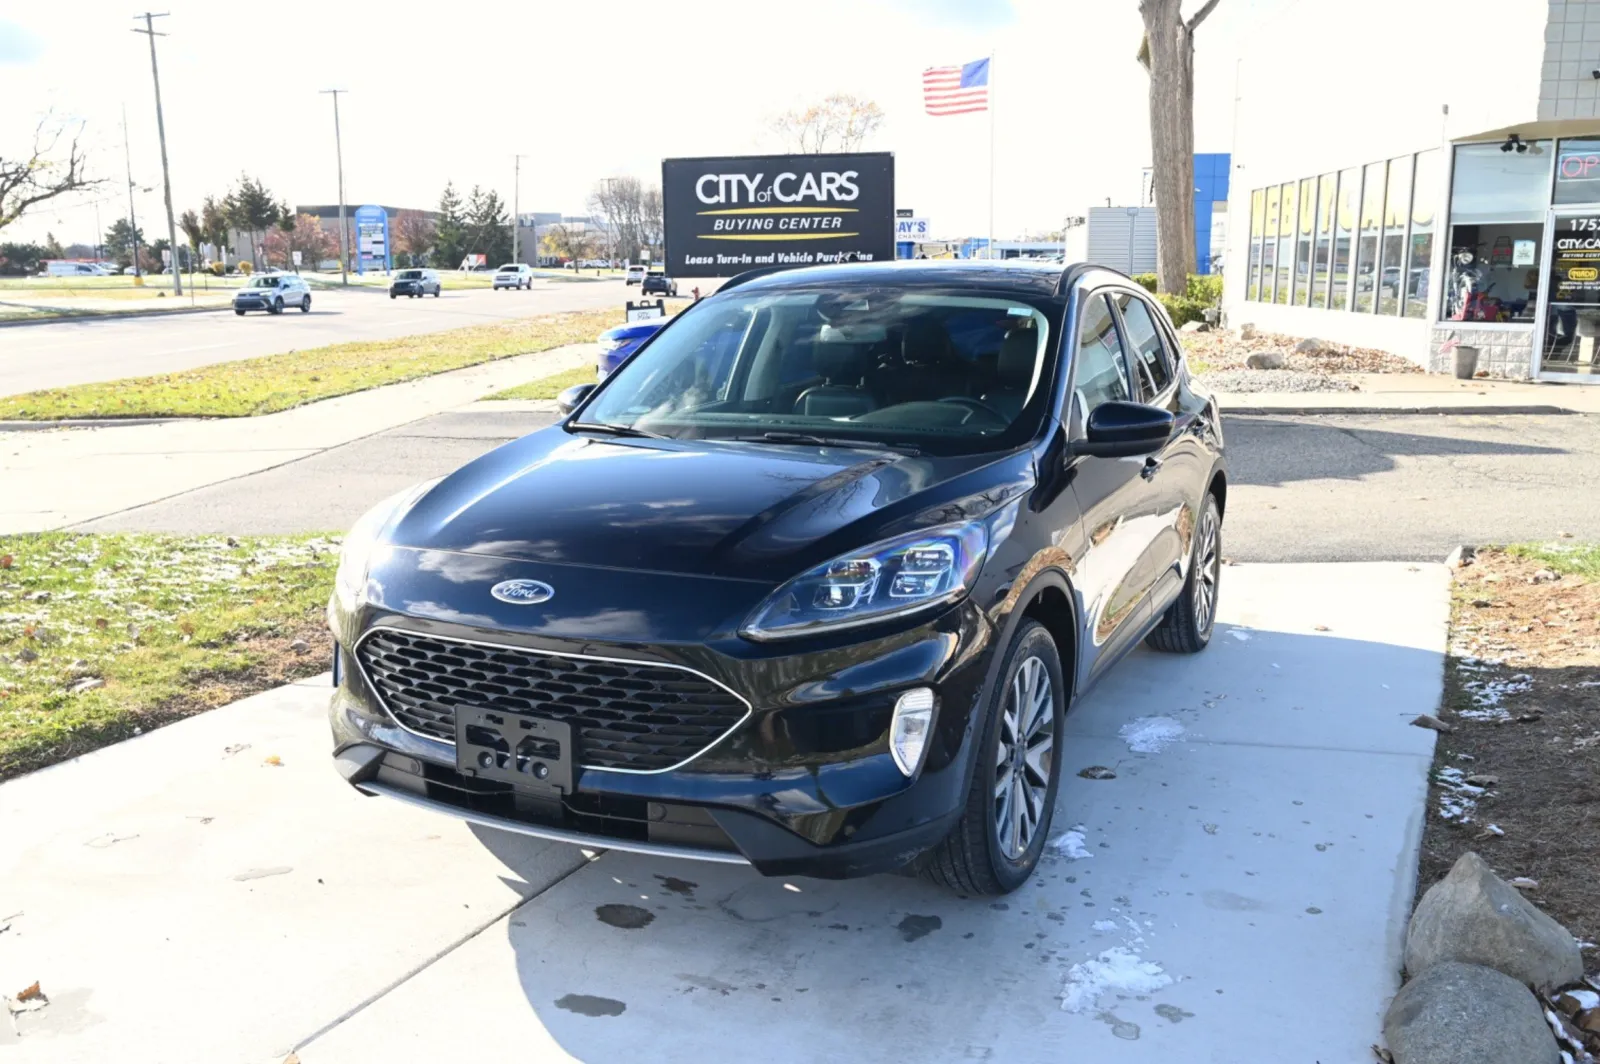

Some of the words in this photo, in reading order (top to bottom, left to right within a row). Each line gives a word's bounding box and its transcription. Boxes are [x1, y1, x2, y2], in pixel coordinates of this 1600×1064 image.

[695, 173, 764, 204] CITY
[757, 185, 773, 203] of
[773, 170, 860, 203] CARS
[714, 218, 775, 231] BUYING
[779, 216, 842, 230] CENTER
[1557, 238, 1583, 249] CITY
[685, 254, 713, 265] Lease
[717, 253, 751, 264] Turn-In
[755, 252, 774, 263] and
[777, 251, 813, 263] Vehicle
[503, 582, 540, 598] Ford
